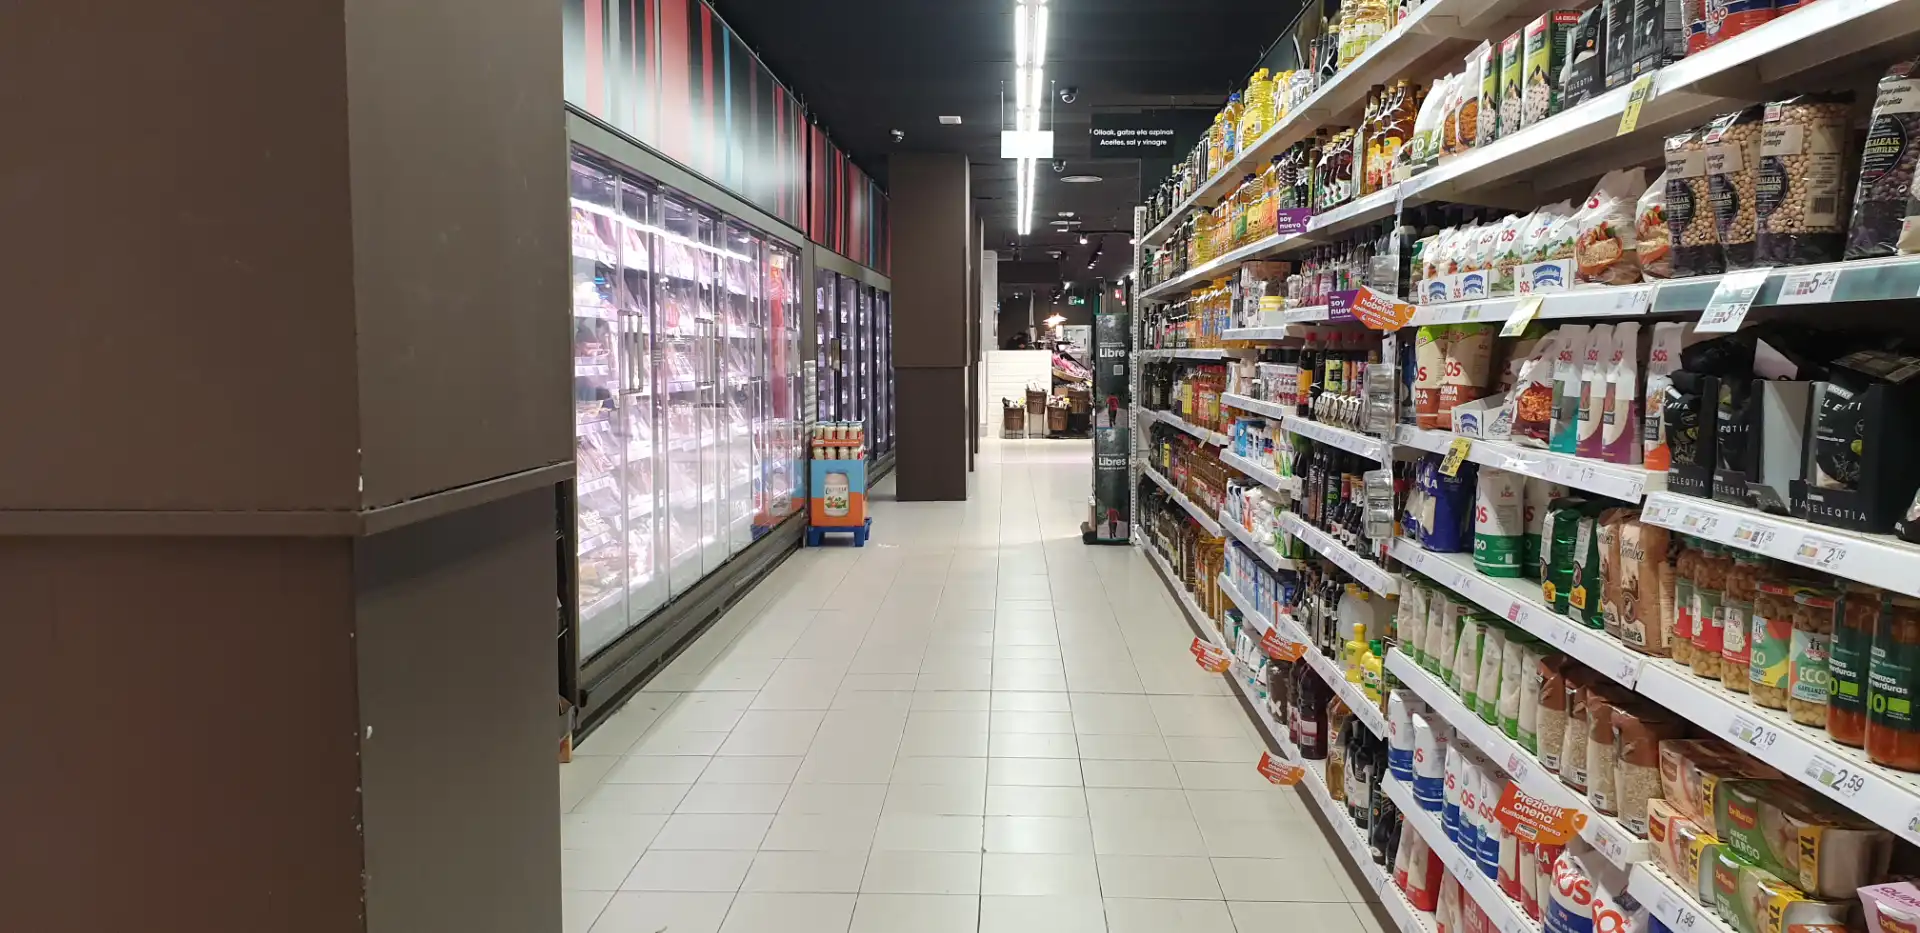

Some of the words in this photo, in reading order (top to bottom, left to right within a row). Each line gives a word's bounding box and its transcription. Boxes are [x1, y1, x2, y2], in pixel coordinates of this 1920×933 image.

[1100, 139, 1125, 147] Aceites,
[1142, 139, 1168, 147] vinagre
[1519, 281, 1530, 293] SOS
[1809, 271, 1837, 294] 5,24
[1330, 299, 1345, 309] soy
[1370, 294, 1394, 309] Prezio
[1330, 306, 1351, 315] nuev
[1099, 347, 1125, 359] Libre
[1559, 350, 1573, 362] SOS
[1652, 350, 1668, 362] SOS
[1098, 457, 1127, 467] Libres
[1668, 474, 1705, 488] SELEQTIA
[1807, 503, 1867, 521] SELEQTIA
[1824, 548, 1847, 563] 2,19
[1800, 666, 1828, 685] ECO
[1750, 726, 1777, 747] 2,19
[1831, 768, 1865, 792] 2,59
[1514, 790, 1564, 819] Preziorik
[1514, 802, 1555, 826] onena.
[1538, 822, 1561, 837] marka
[1730, 837, 1760, 861] LARGO
[1800, 835, 1816, 862] XL
[1769, 904, 1781, 930] XL
